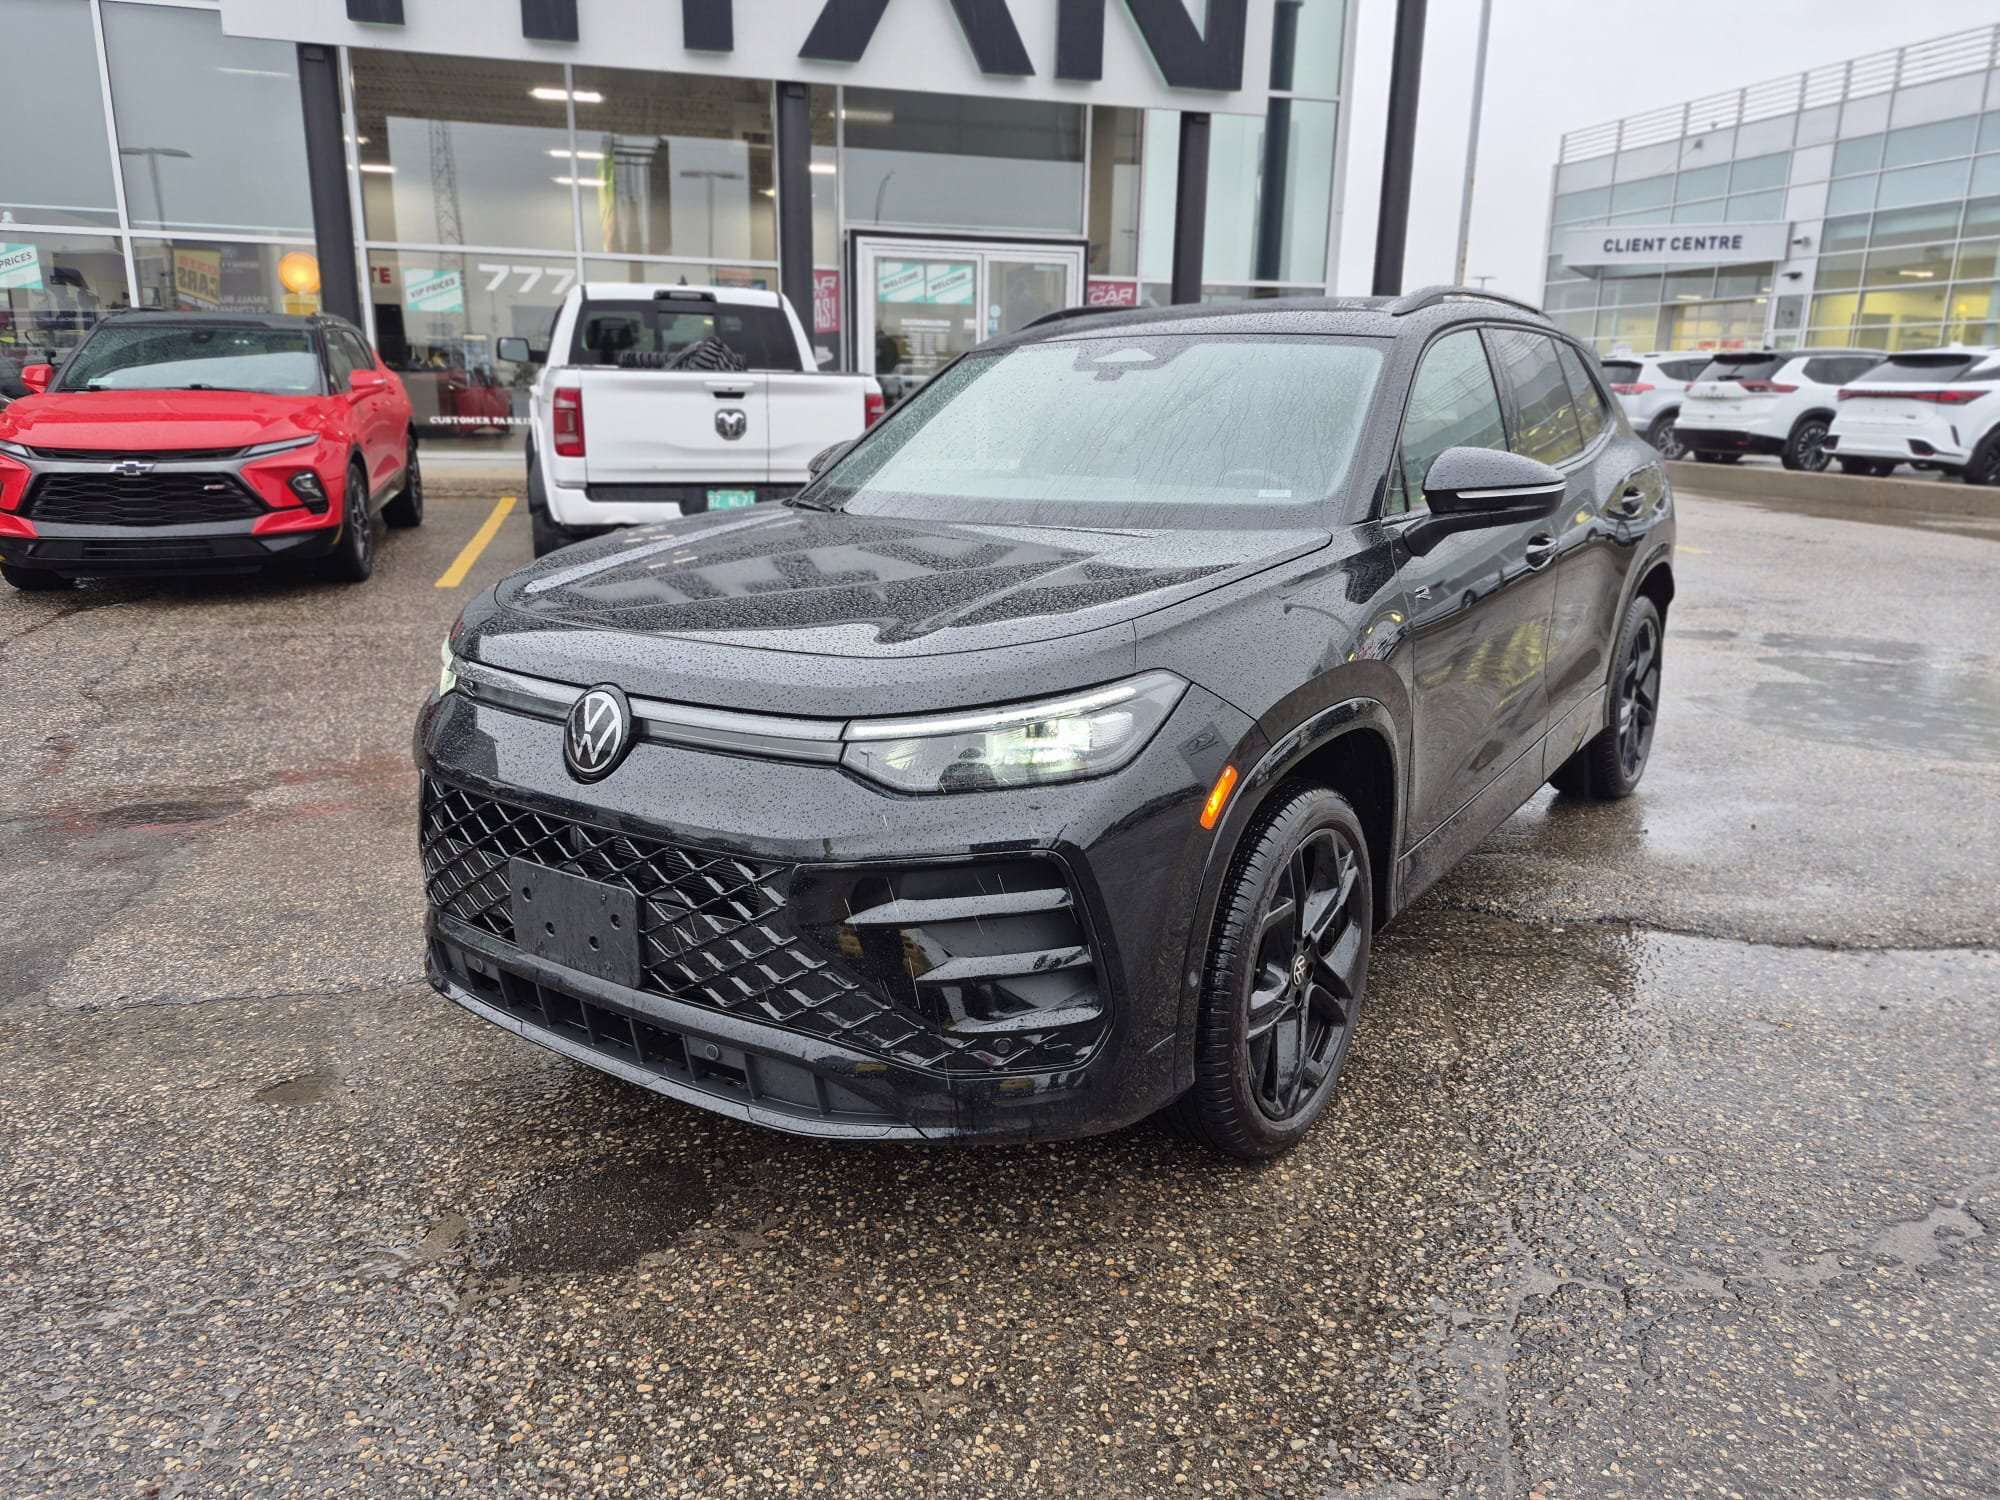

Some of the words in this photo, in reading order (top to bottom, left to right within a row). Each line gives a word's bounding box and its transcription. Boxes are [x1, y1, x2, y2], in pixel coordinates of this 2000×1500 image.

[1603, 238, 1666, 253] CLIENT
[1671, 235, 1743, 250] CENTRE
[0, 251, 33, 269] PRICES
[425, 277, 456, 293] PRICES
[883, 272, 918, 289] WELCOME
[931, 272, 966, 291] WELCOME
[1090, 288, 1133, 304] CAR
[429, 416, 491, 425] CUSTOMER
